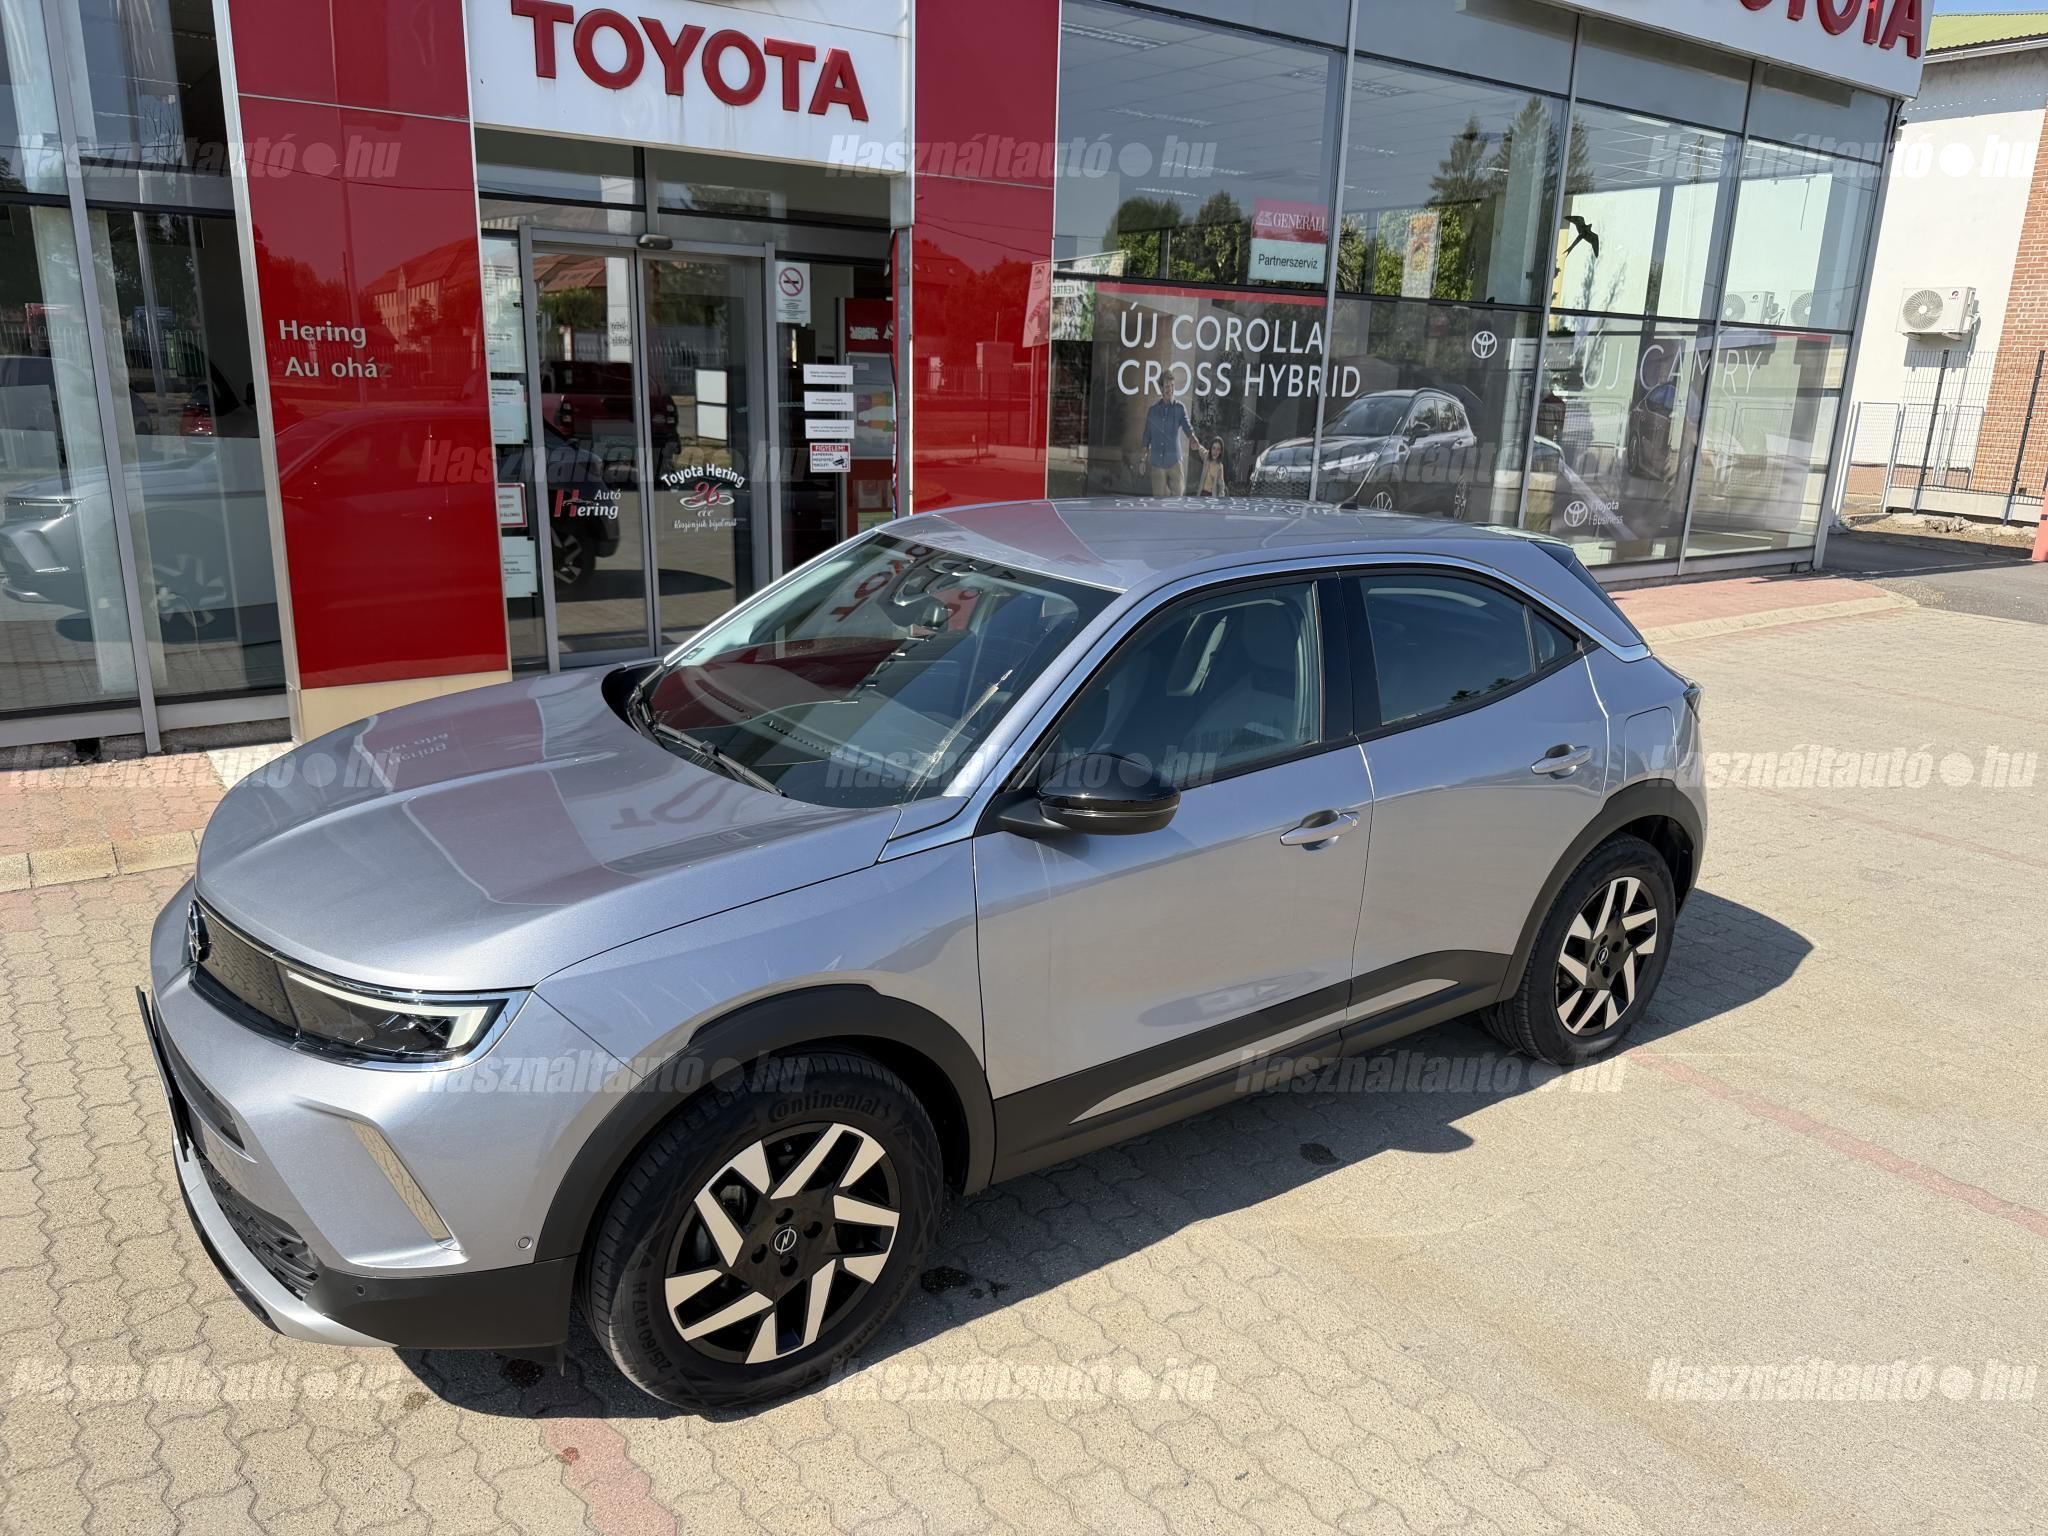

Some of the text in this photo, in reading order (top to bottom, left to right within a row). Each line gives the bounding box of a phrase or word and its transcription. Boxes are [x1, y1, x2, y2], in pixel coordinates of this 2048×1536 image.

[511, 0, 869, 122] TOYOTA
[1273, 212, 1326, 232] GENERALI
[1258, 253, 1318, 270] Partnerszerviz
[279, 319, 367, 349] Hering
[1120, 302, 1324, 355] ÚJ COROLLA
[1117, 359, 1361, 398] CROSS HYBRID
[1640, 344, 1763, 394] CAMRY
[660, 463, 746, 489] Toyota Hering
[594, 488, 621, 501] Autó
[767, 1089, 881, 1123] Continental
